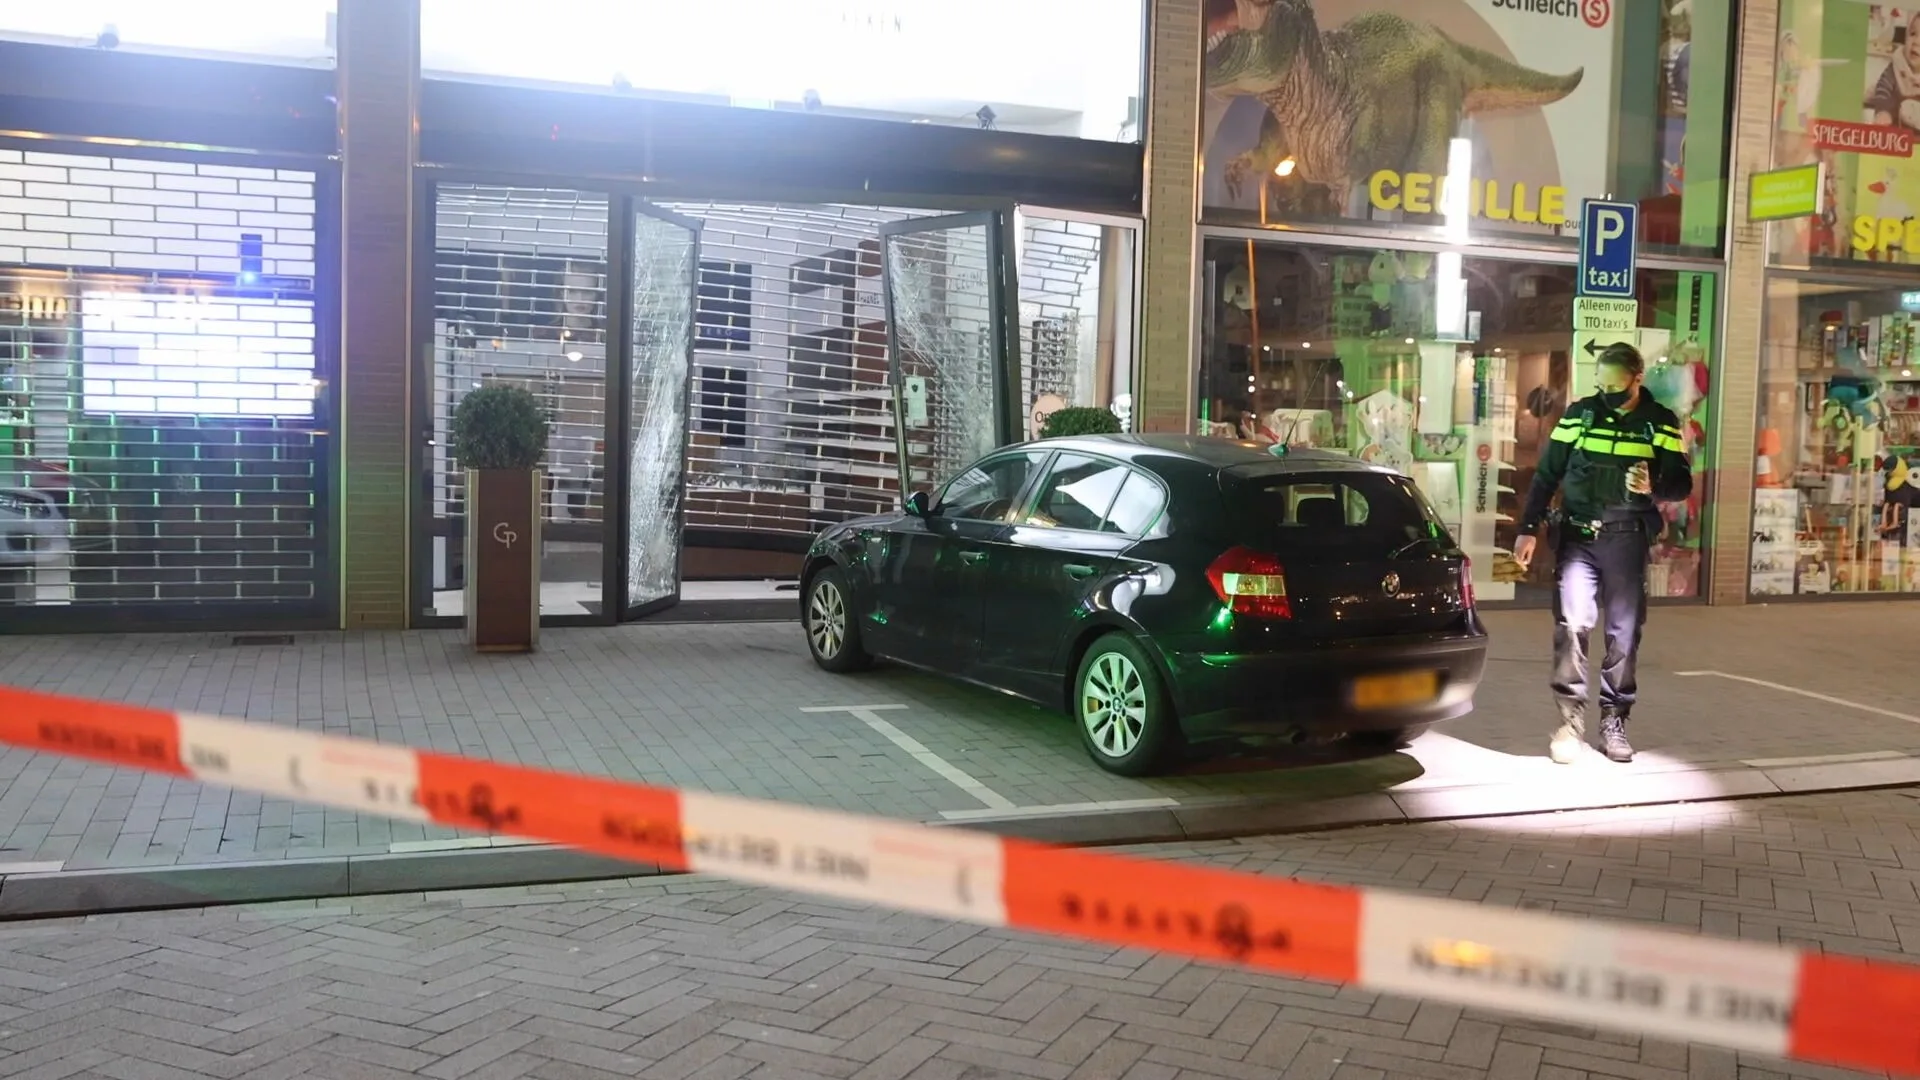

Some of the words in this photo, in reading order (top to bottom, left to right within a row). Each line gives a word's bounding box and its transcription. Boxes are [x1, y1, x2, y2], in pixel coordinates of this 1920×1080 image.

[1812, 124, 1909, 152] SPIEGELBURG
[1595, 209, 1625, 256] P
[1588, 266, 1629, 288] taxi
[1579, 299, 1611, 311] Alleen
[1613, 302, 1636, 312] voor
[1584, 316, 1601, 329] TTO
[1602, 318, 1628, 330] taxi's
[1476, 462, 1488, 513] Schleich
